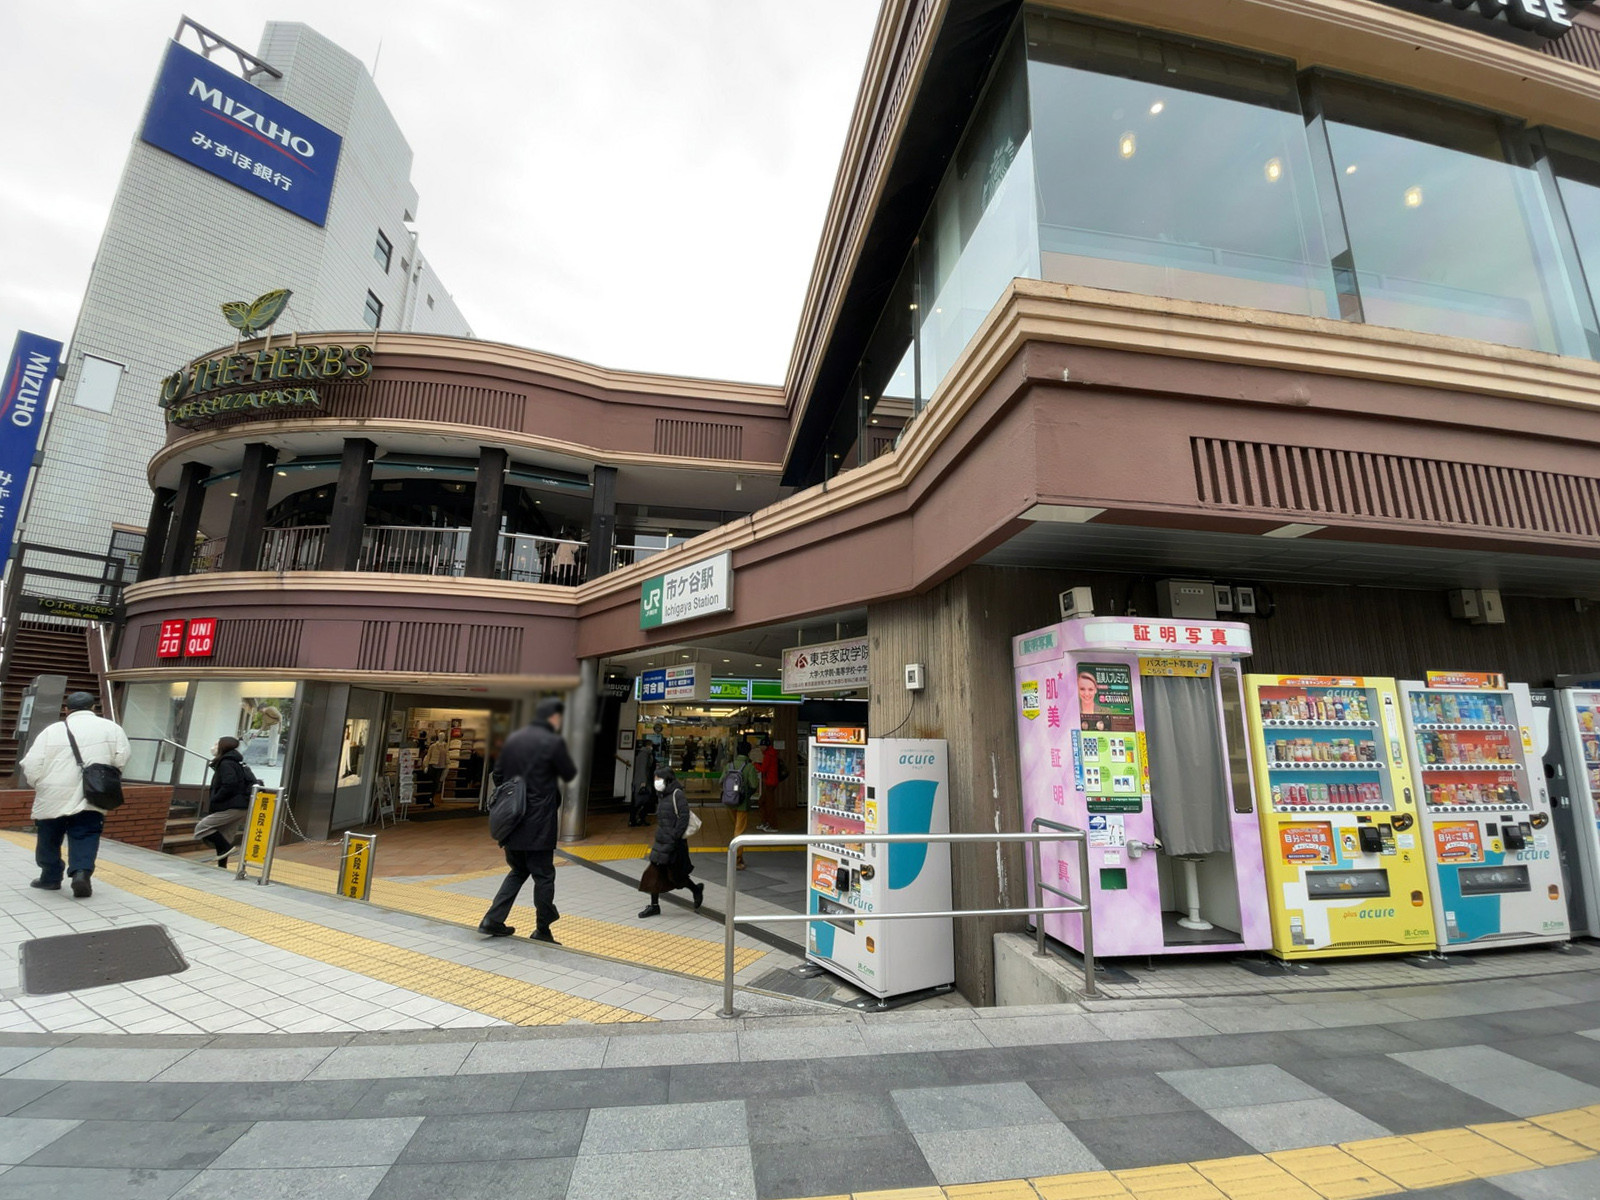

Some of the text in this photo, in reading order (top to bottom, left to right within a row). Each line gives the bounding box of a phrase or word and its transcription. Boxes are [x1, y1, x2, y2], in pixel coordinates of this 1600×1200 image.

[188, 77, 315, 158] MIZUHO
[191, 131, 292, 191] みずほ銀行
[191, 351, 247, 394] THE
[251, 344, 374, 382] HERBS
[12, 351, 51, 428] MIZUHO
[167, 402, 198, 424] CAFE
[212, 392, 256, 411] PIZZA
[260, 387, 321, 407] PASTA
[38, 598, 55, 608] TO
[57, 600, 77, 611] THE
[80, 604, 114, 616] HERBS
[643, 588, 661, 611] JR
[665, 600, 692, 617] Ichigaya
[693, 594, 719, 610] Station
[191, 622, 211, 636] UNI
[1133, 624, 1228, 645] 証明写真
[189, 638, 210, 653] QLO
[1326, 689, 1360, 697] acure
[899, 754, 936, 765] acure
[1516, 849, 1550, 861] acure
[847, 895, 874, 913] acure
[1359, 908, 1395, 919] acure
